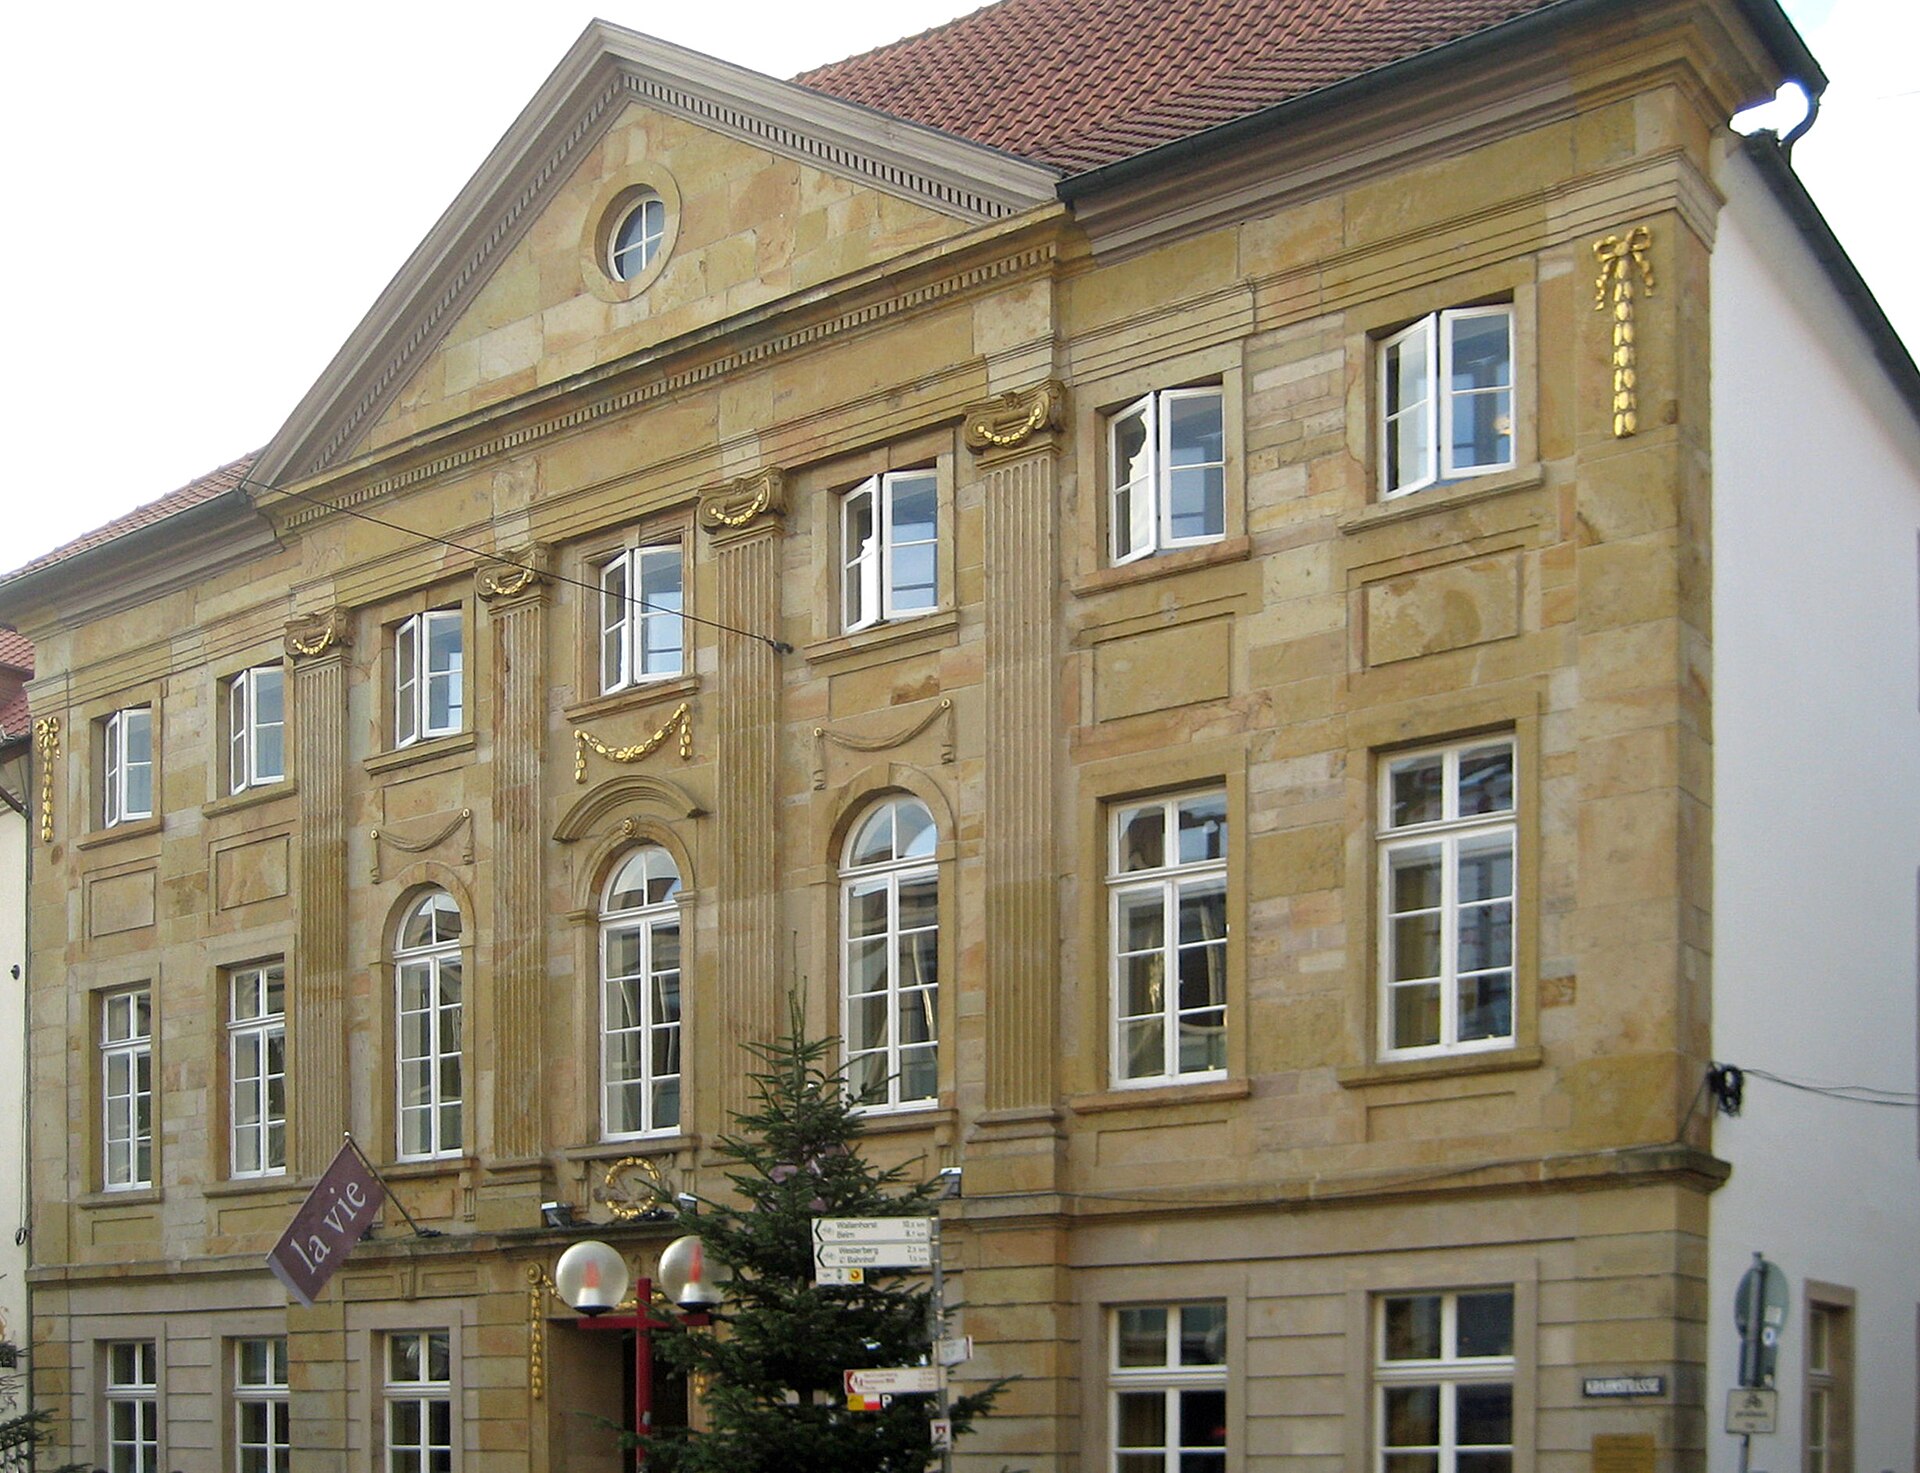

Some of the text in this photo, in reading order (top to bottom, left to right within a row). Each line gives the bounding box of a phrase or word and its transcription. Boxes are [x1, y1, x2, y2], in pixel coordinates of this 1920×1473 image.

[290, 1181, 366, 1275] la vie
[838, 1246, 879, 1255] Westerberg
